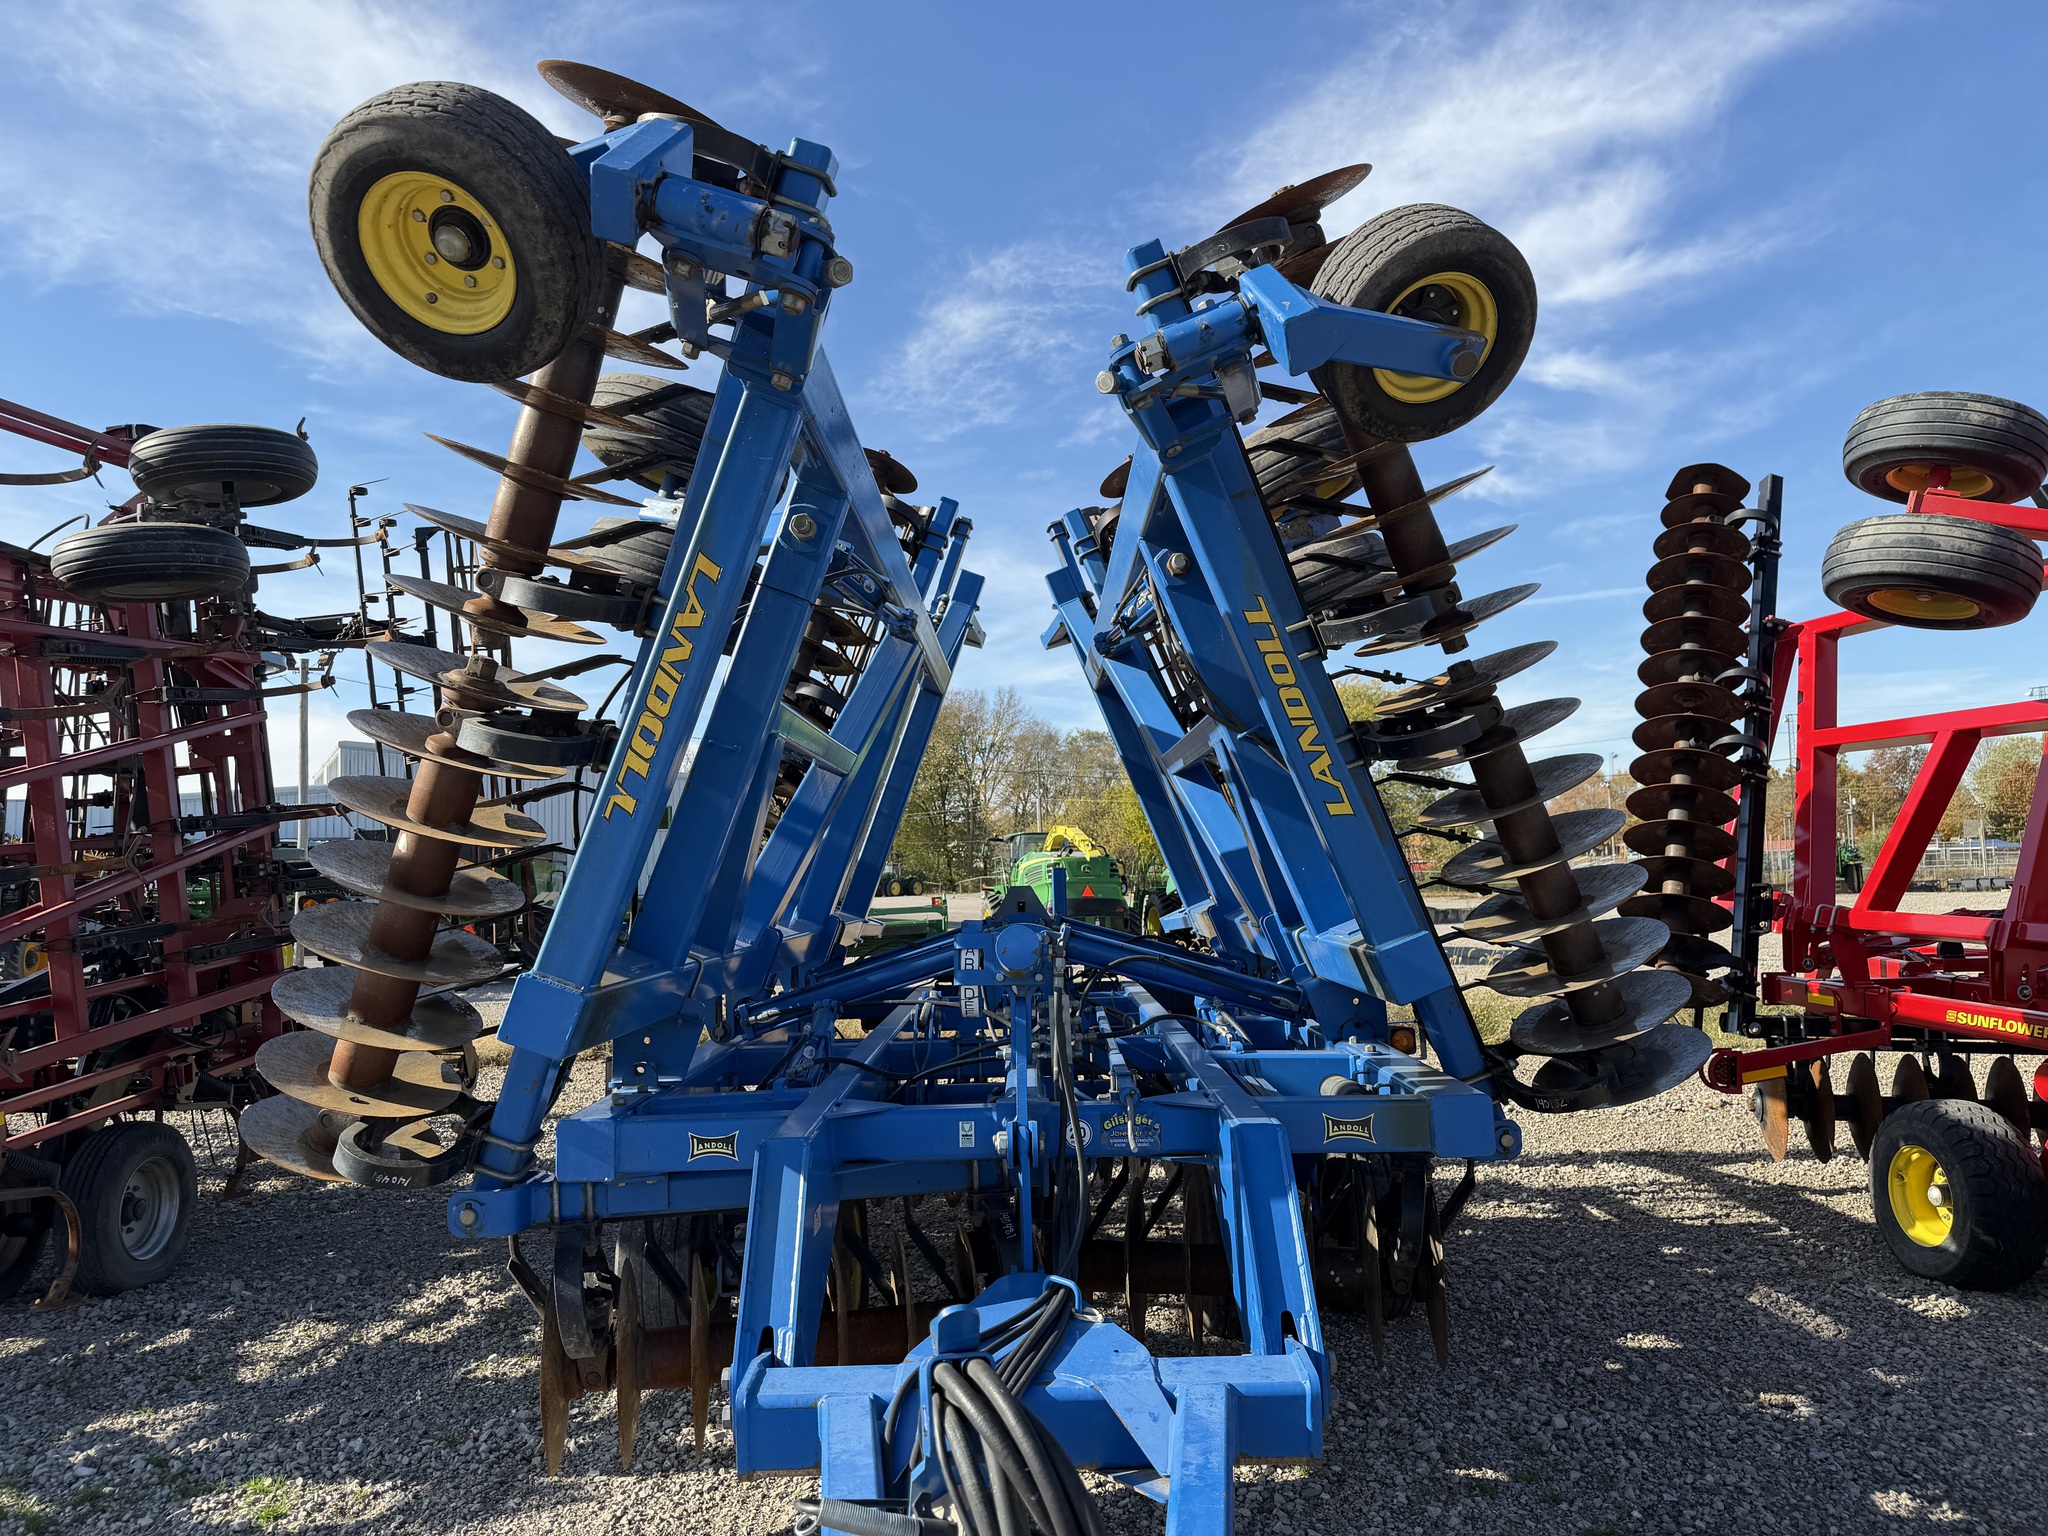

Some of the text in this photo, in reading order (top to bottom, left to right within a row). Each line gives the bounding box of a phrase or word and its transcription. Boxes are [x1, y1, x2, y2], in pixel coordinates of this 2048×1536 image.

[601, 549, 723, 824] LANDOLL
[1242, 593, 1357, 817] LANDOLL
[964, 958, 975, 970] B
[964, 987, 975, 999] D
[1328, 1119, 1370, 1137] LANDOLL
[693, 1138, 733, 1155] LANDOLL
